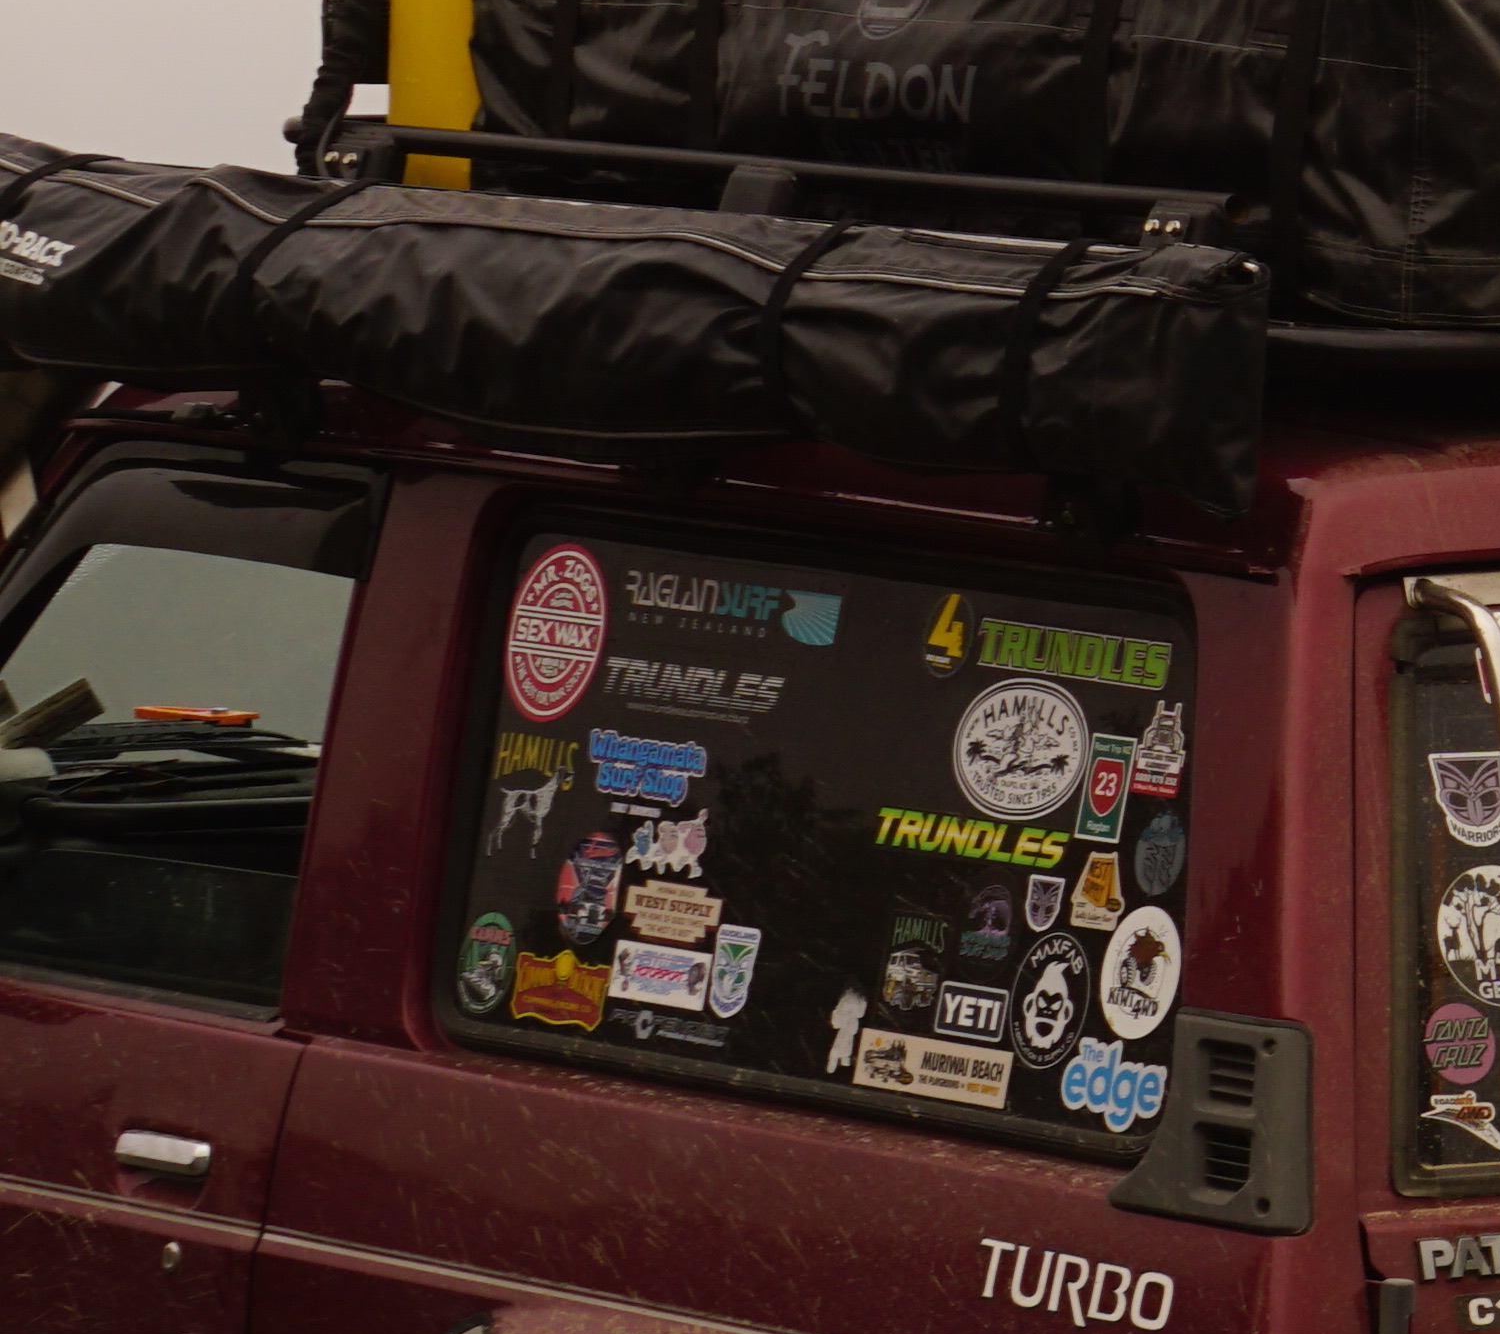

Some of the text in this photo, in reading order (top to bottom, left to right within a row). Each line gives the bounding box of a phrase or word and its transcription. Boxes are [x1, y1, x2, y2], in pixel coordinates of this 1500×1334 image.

[778, 28, 977, 124] FELDON
[515, 617, 596, 650] SEX WAX
[927, 593, 964, 658] 4
[977, 618, 1172, 689] TRUNDLES
[603, 656, 786, 713] TRUNDLES
[983, 695, 1070, 736] HAMILLS
[492, 732, 579, 791] HAMILLS
[588, 728, 707, 777] Whangamata
[598, 762, 688, 807] Surf Shop
[1007, 791, 1033, 805] SINCE
[1094, 771, 1118, 796] 23
[875, 806, 1071, 869] TRUNDLES
[634, 894, 714, 918] WEST SUPPLY
[891, 917, 949, 953] HAMILLS
[1030, 938, 1084, 975] MAXFAB
[943, 993, 1003, 1031] YETI
[1422, 1017, 1490, 1043] SANTA
[920, 1050, 1006, 1083] MURIWAI BEACH
[1082, 1044, 1105, 1063] The
[1431, 1043, 1488, 1070] CRUZ
[1064, 1047, 1161, 1127] edge
[980, 1237, 1175, 1331] TURBO
